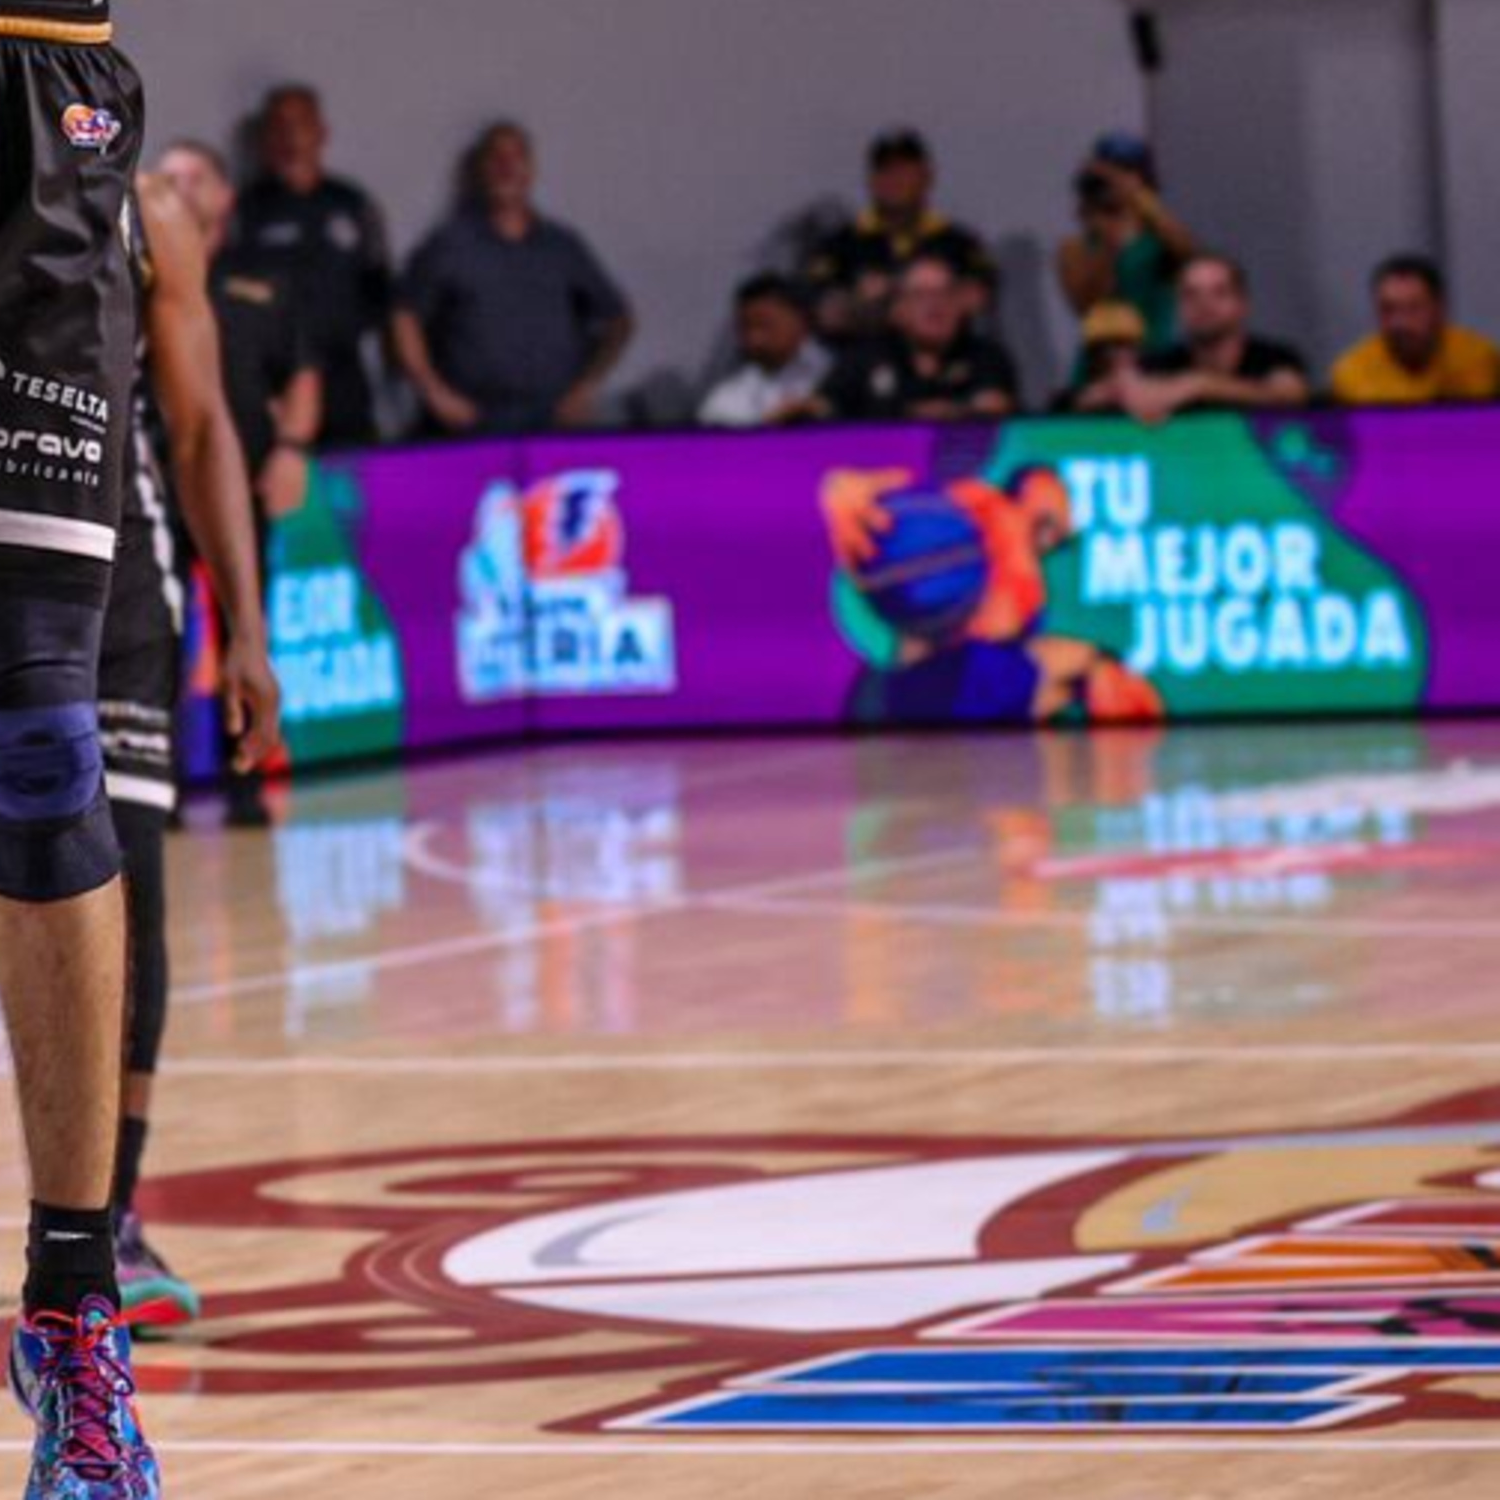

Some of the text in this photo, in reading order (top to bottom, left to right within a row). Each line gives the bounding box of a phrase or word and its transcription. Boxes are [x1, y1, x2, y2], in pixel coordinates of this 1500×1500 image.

[12, 370, 109, 423] TESELTA
[1057, 457, 1153, 532] TU
[1078, 521, 1320, 602] MEJOR
[1123, 588, 1411, 673] JUGADA
